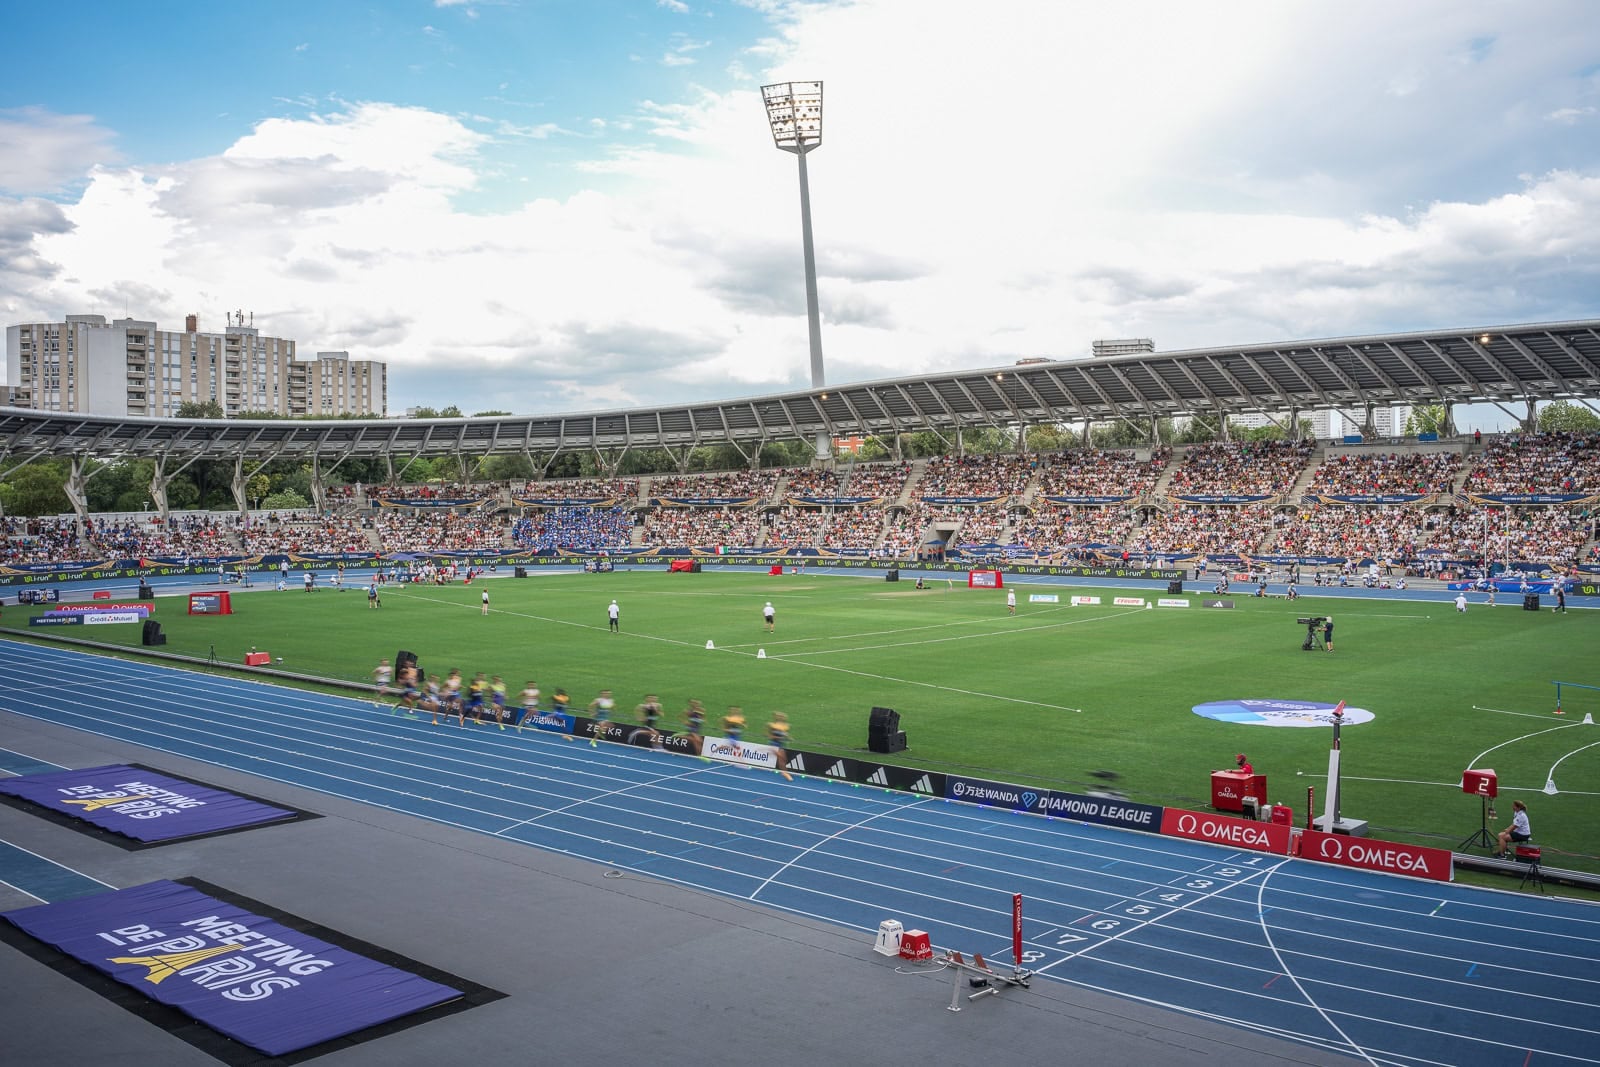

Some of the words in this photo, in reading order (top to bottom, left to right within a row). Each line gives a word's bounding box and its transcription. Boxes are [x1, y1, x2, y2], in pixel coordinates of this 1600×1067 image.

[650, 733, 688, 747] ZEEKR
[741, 746, 769, 762] Mutuel
[1478, 777, 1489, 792] 2
[114, 781, 207, 810] MEETING
[1217, 791, 1238, 799] OMEGA
[1038, 796, 1098, 816] DIAMOND
[1100, 804, 1152, 824] LEAGUE
[1201, 821, 1270, 847] OMEGA
[1243, 857, 1263, 865] 1
[1348, 845, 1429, 873] OMEGA
[1213, 867, 1241, 877] 2
[1186, 879, 1213, 889] 3
[1158, 891, 1184, 903] 4
[1126, 904, 1157, 916] 5
[1091, 918, 1121, 930] 6
[112, 923, 167, 943] DE
[895, 933, 900, 946] 1
[1056, 933, 1088, 945] 7
[180, 915, 334, 977] MEETING
[106, 935, 301, 1002] PARIS
